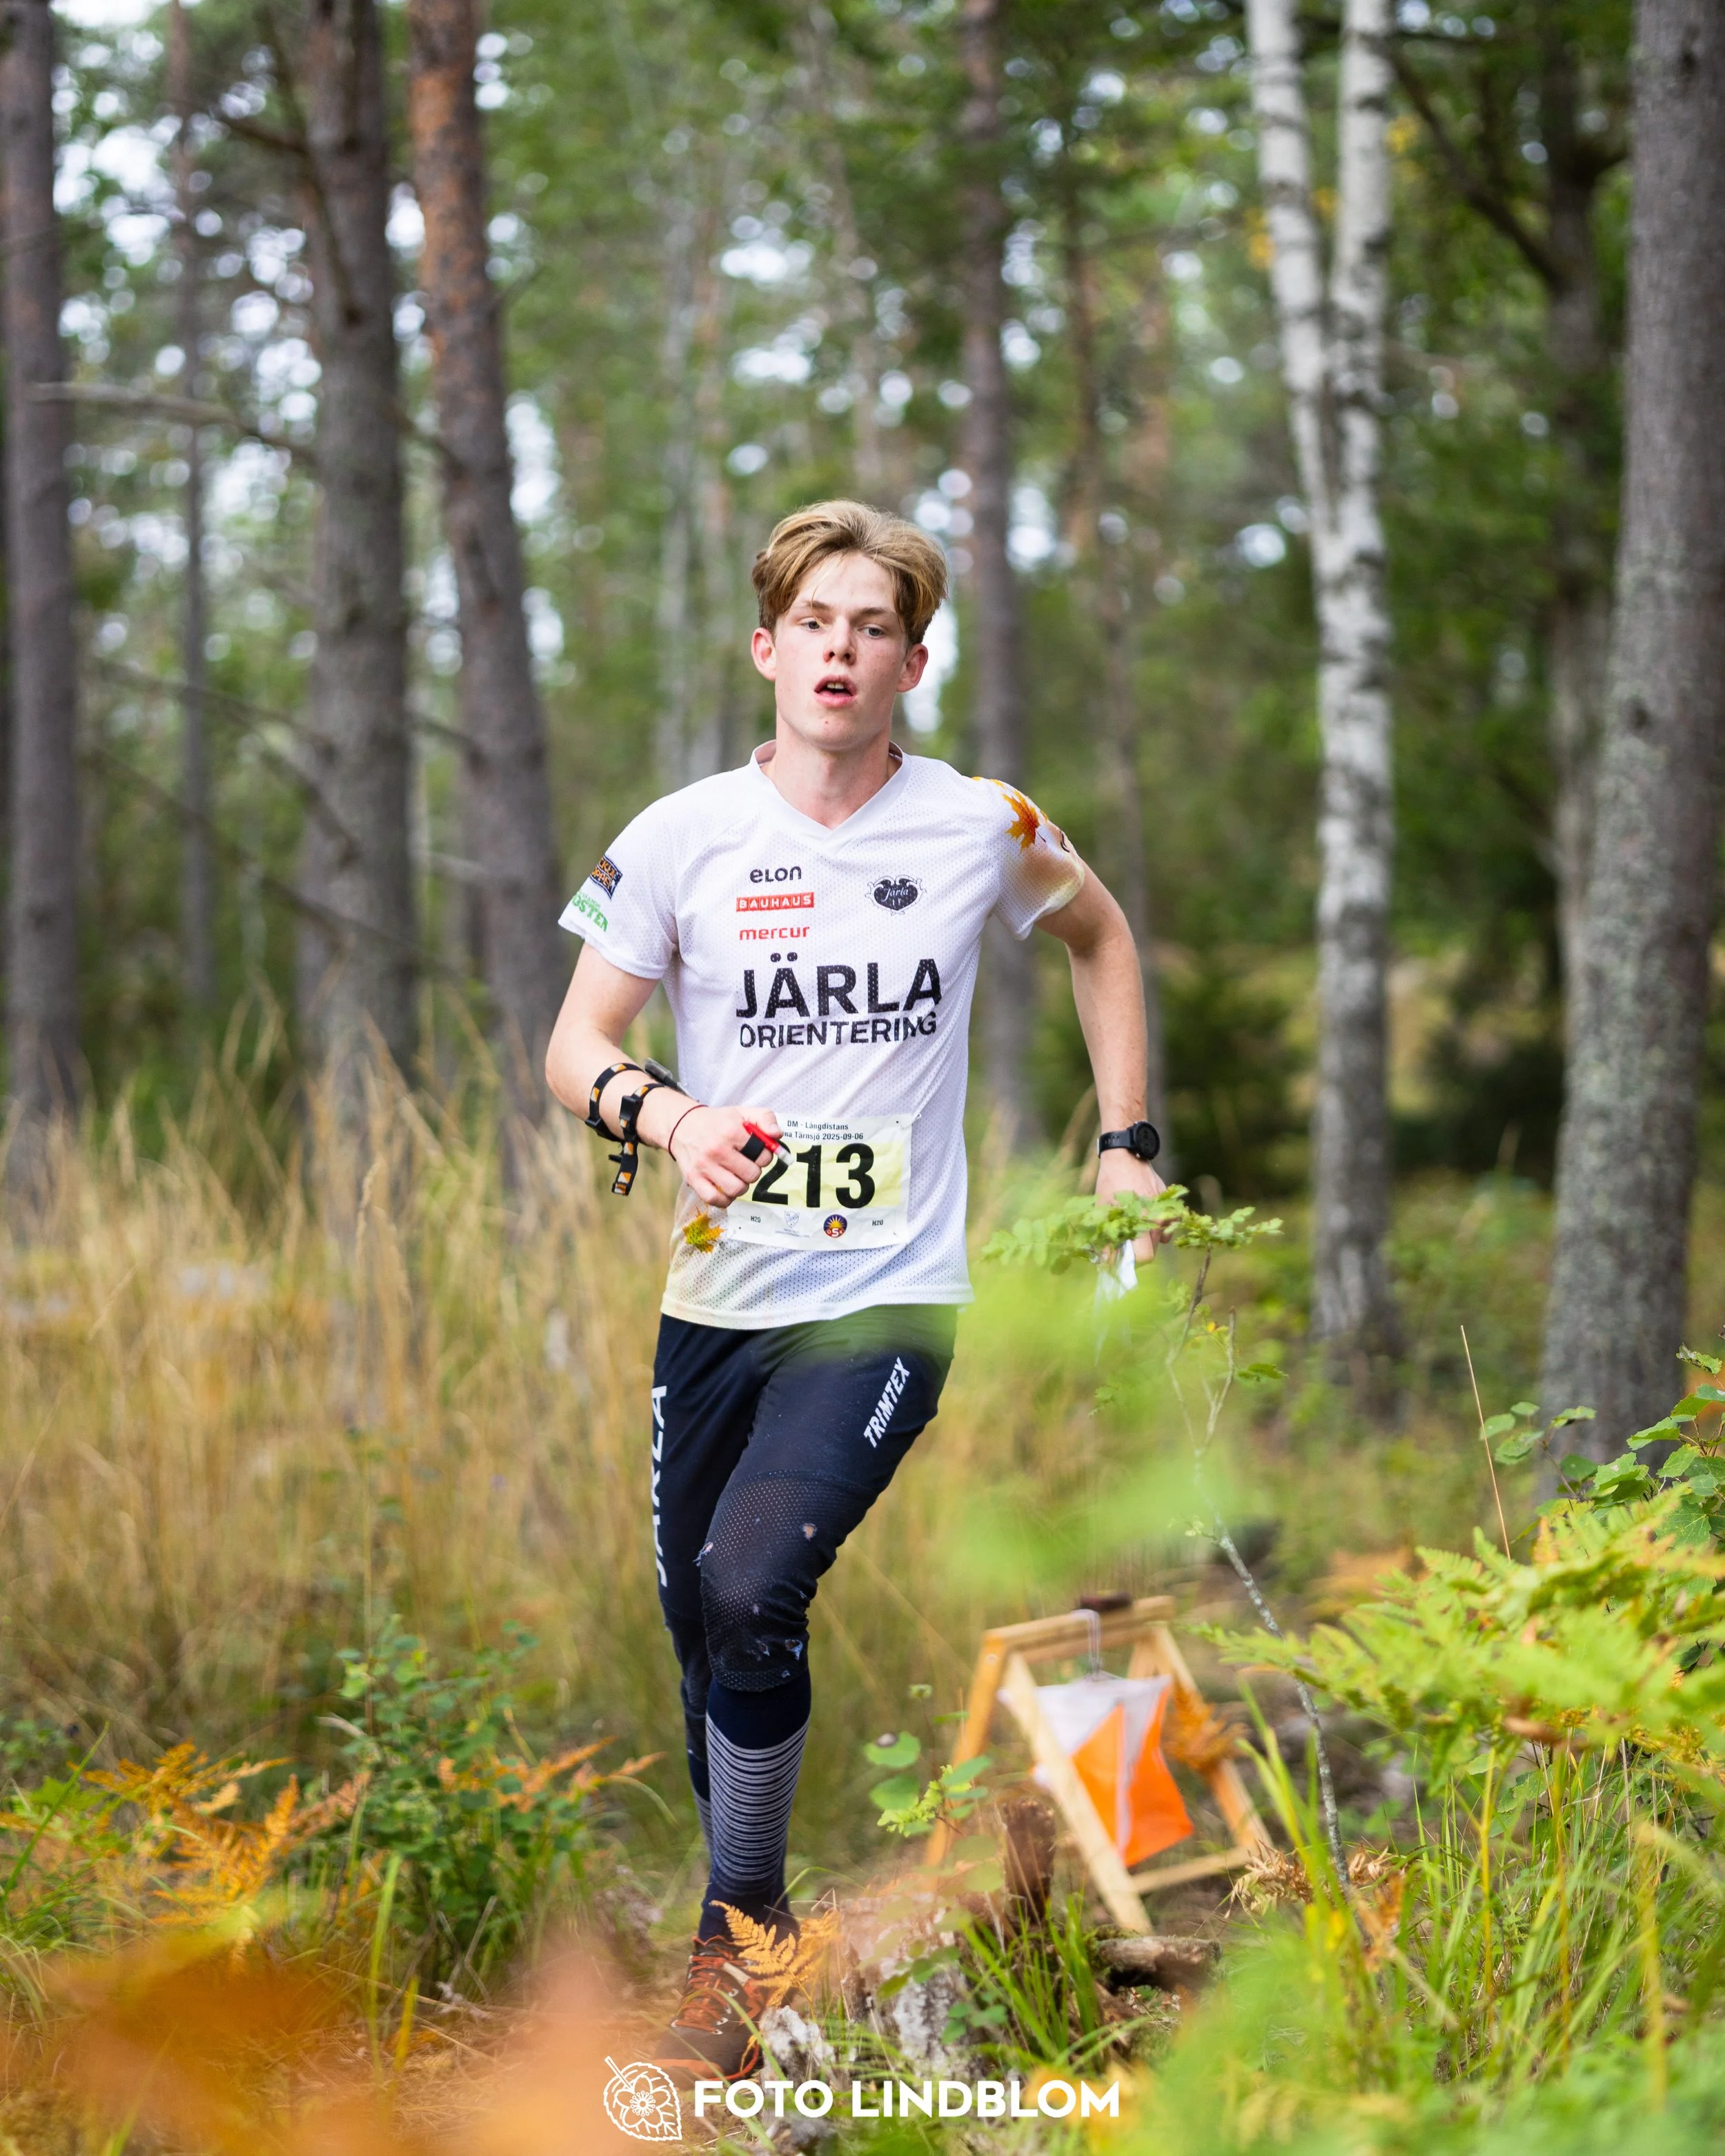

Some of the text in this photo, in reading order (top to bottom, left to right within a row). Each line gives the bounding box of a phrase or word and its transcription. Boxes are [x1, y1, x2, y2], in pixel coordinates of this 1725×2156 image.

[738, 894, 812, 909] BAUHAUS
[739, 926, 810, 940] mercur
[736, 951, 943, 1018] JÄRLA
[740, 1011, 937, 1049] ORIENTERING
[795, 1131, 820, 1140] Tärnsjö
[822, 1132, 864, 1140] 2025-09-06
[752, 1139, 875, 1209] 213
[863, 1356, 910, 1449] TRIMTEX
